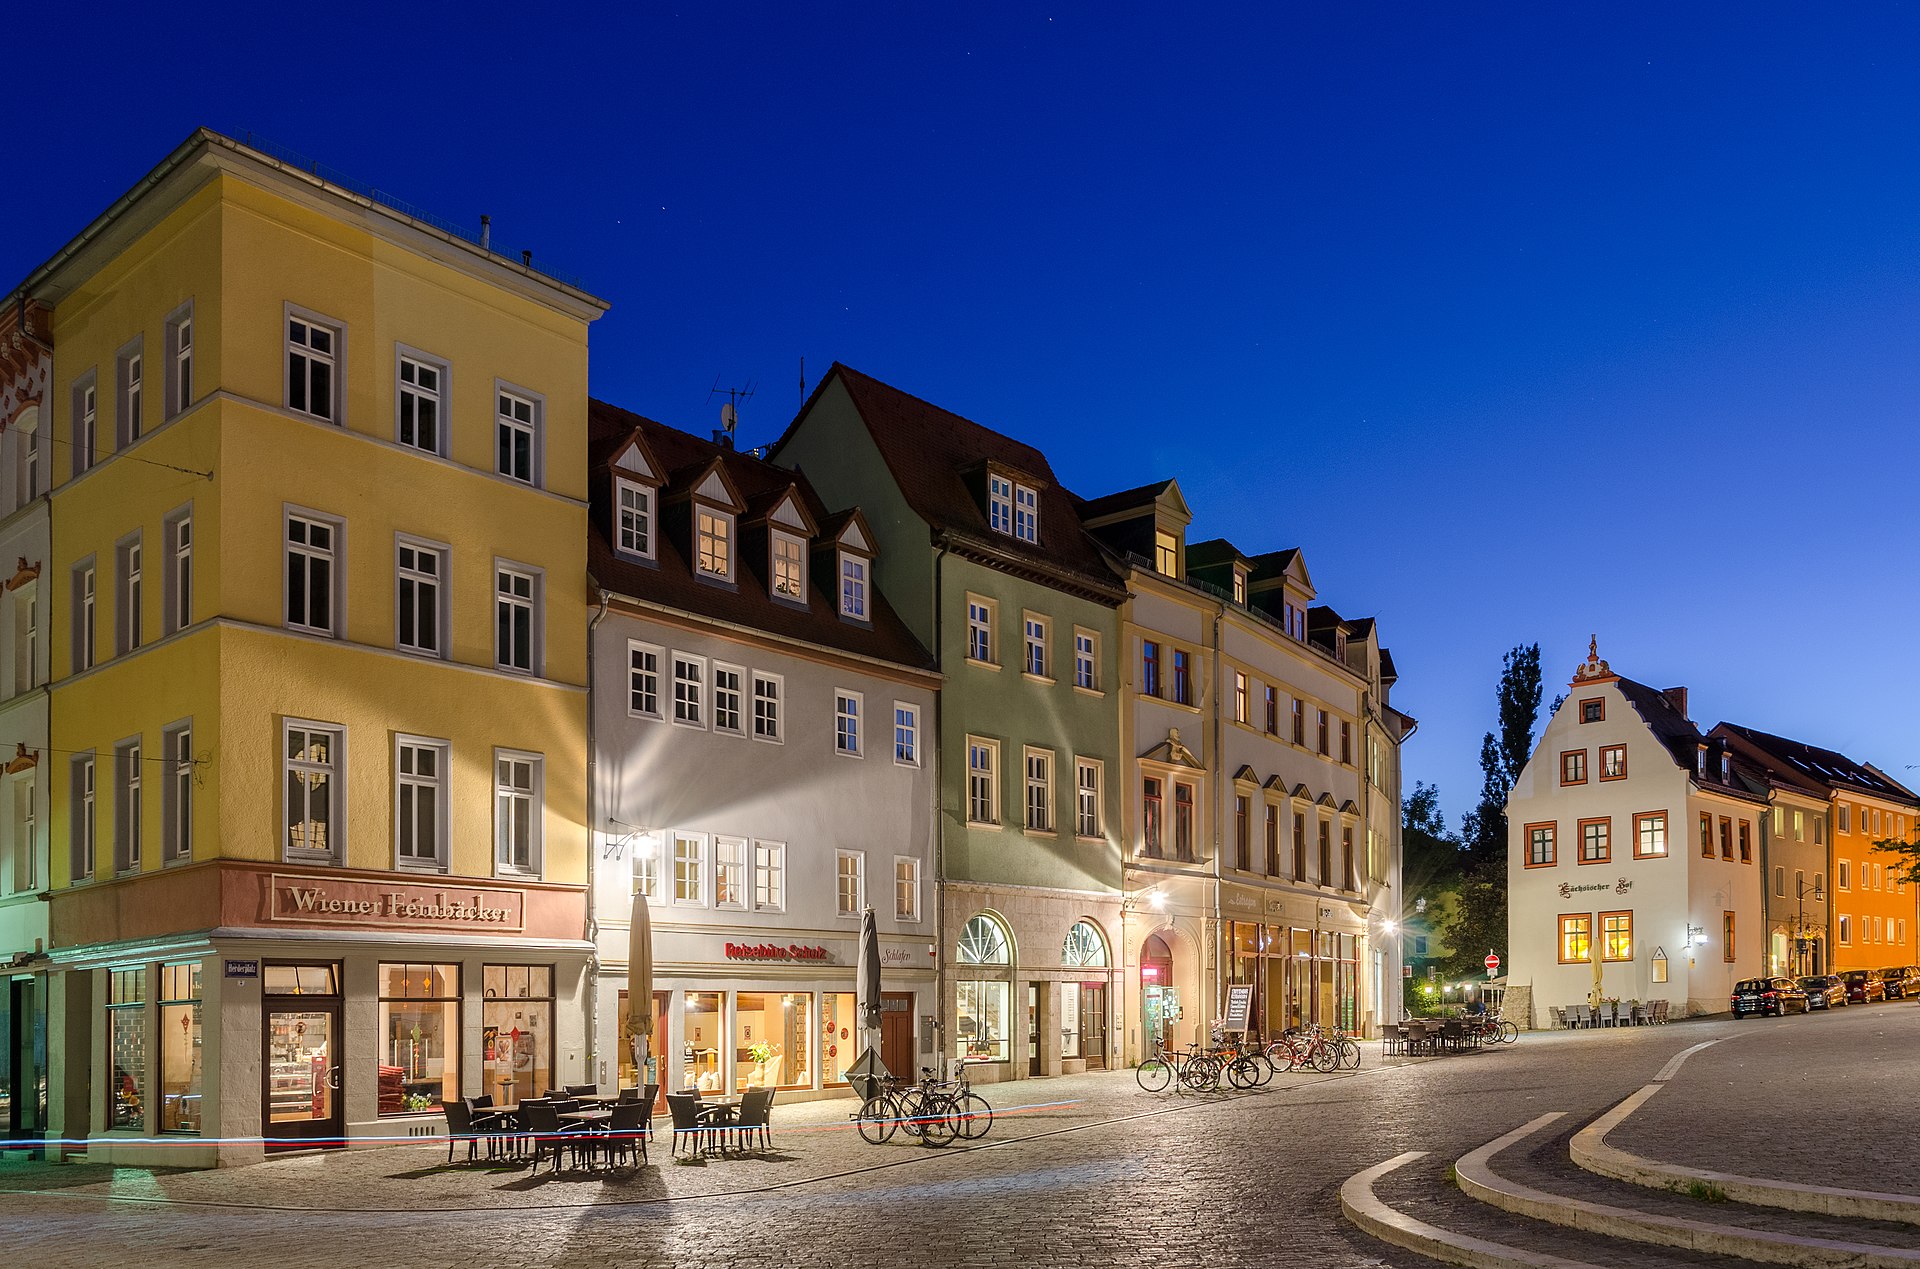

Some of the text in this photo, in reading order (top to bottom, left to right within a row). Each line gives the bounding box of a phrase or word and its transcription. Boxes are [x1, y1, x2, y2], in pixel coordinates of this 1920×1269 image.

[1615, 877, 1632, 895] Hof
[288, 886, 512, 921] Wiener Feinbäcker
[724, 942, 787, 960] Reisebüro
[881, 949, 911, 964] Schlafen
